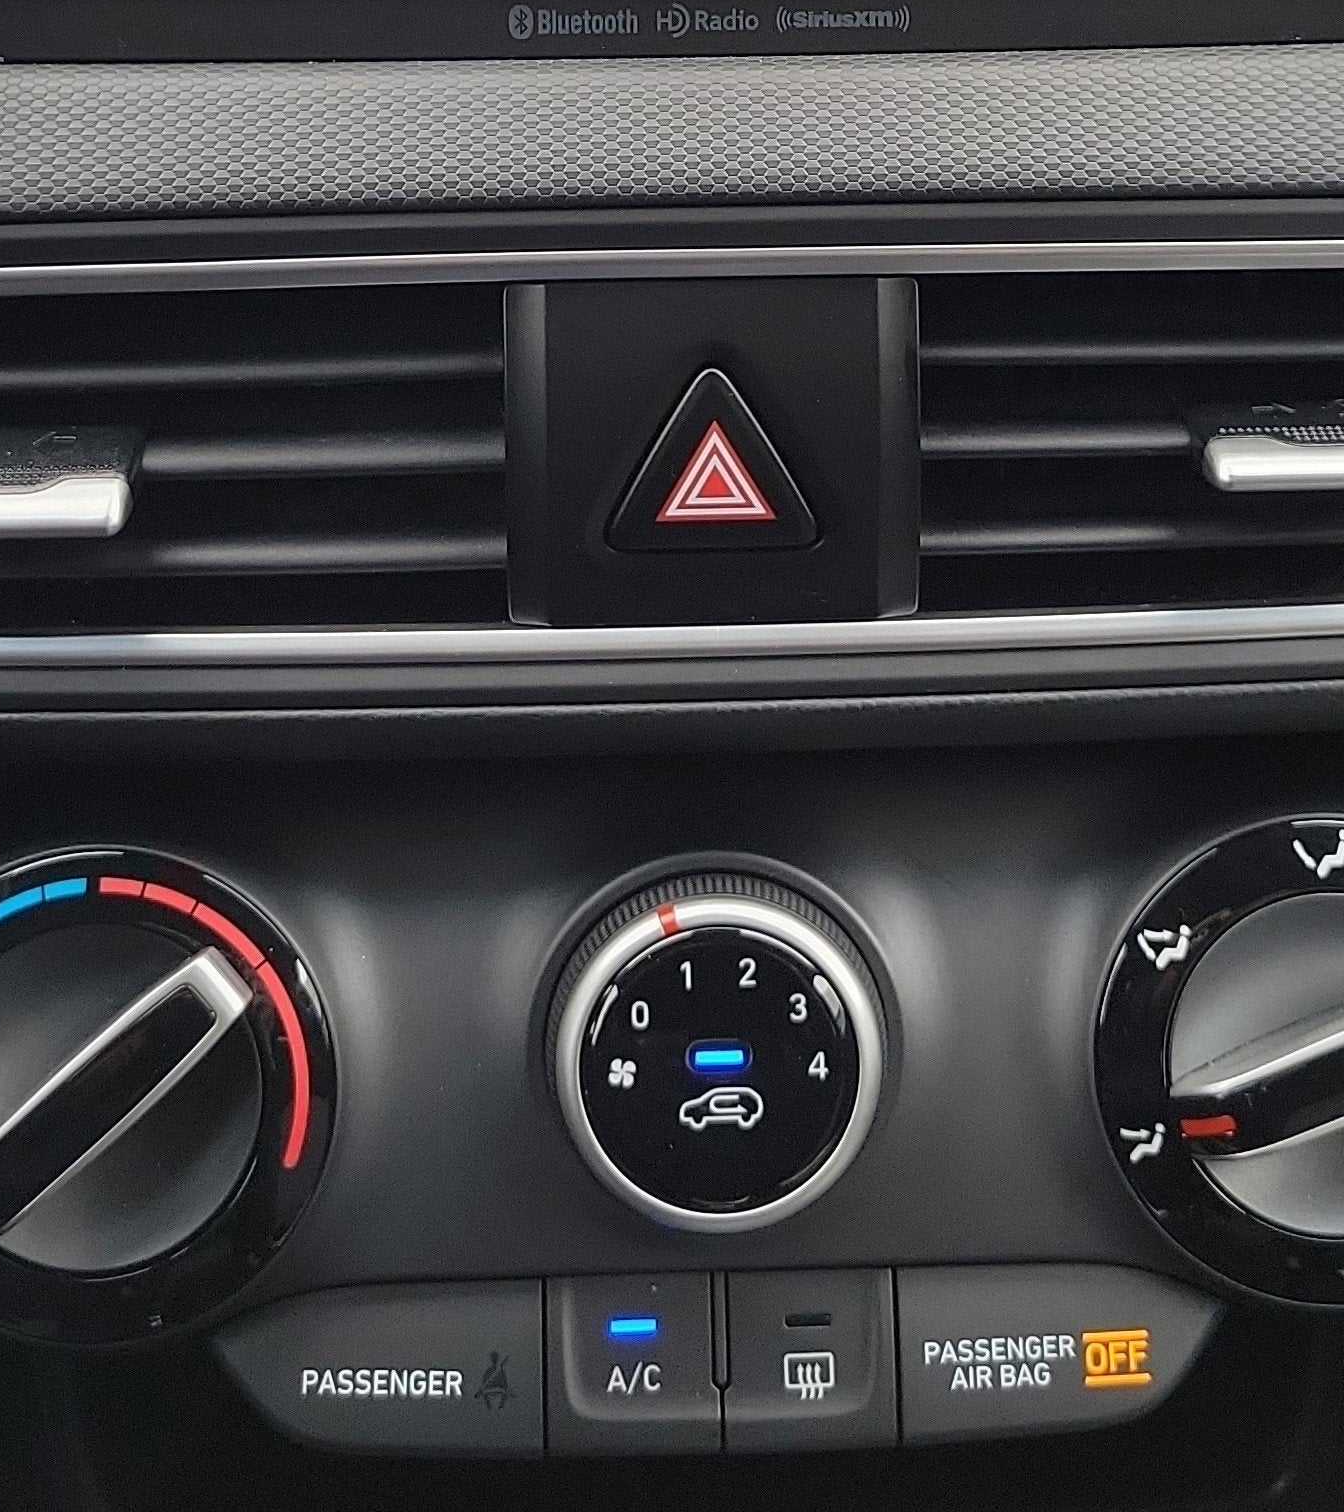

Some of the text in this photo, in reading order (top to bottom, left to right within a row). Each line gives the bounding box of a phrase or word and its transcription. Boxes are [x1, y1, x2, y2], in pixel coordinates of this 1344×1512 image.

[537, 8, 638, 35] Bluetooth
[657, 3, 760, 38] HD Radio
[680, 960, 692, 990] 1
[738, 957, 757, 987] 2
[630, 1000, 650, 1029] 0
[789, 992, 808, 1022] 3
[808, 1051, 829, 1080] 4
[924, 1335, 1077, 1365] PASSENGER
[1084, 1341, 1148, 1374] OFF
[301, 1369, 463, 1397] PASSENGER
[607, 1362, 661, 1395] A/C
[950, 1362, 1053, 1391] AIR BAG
